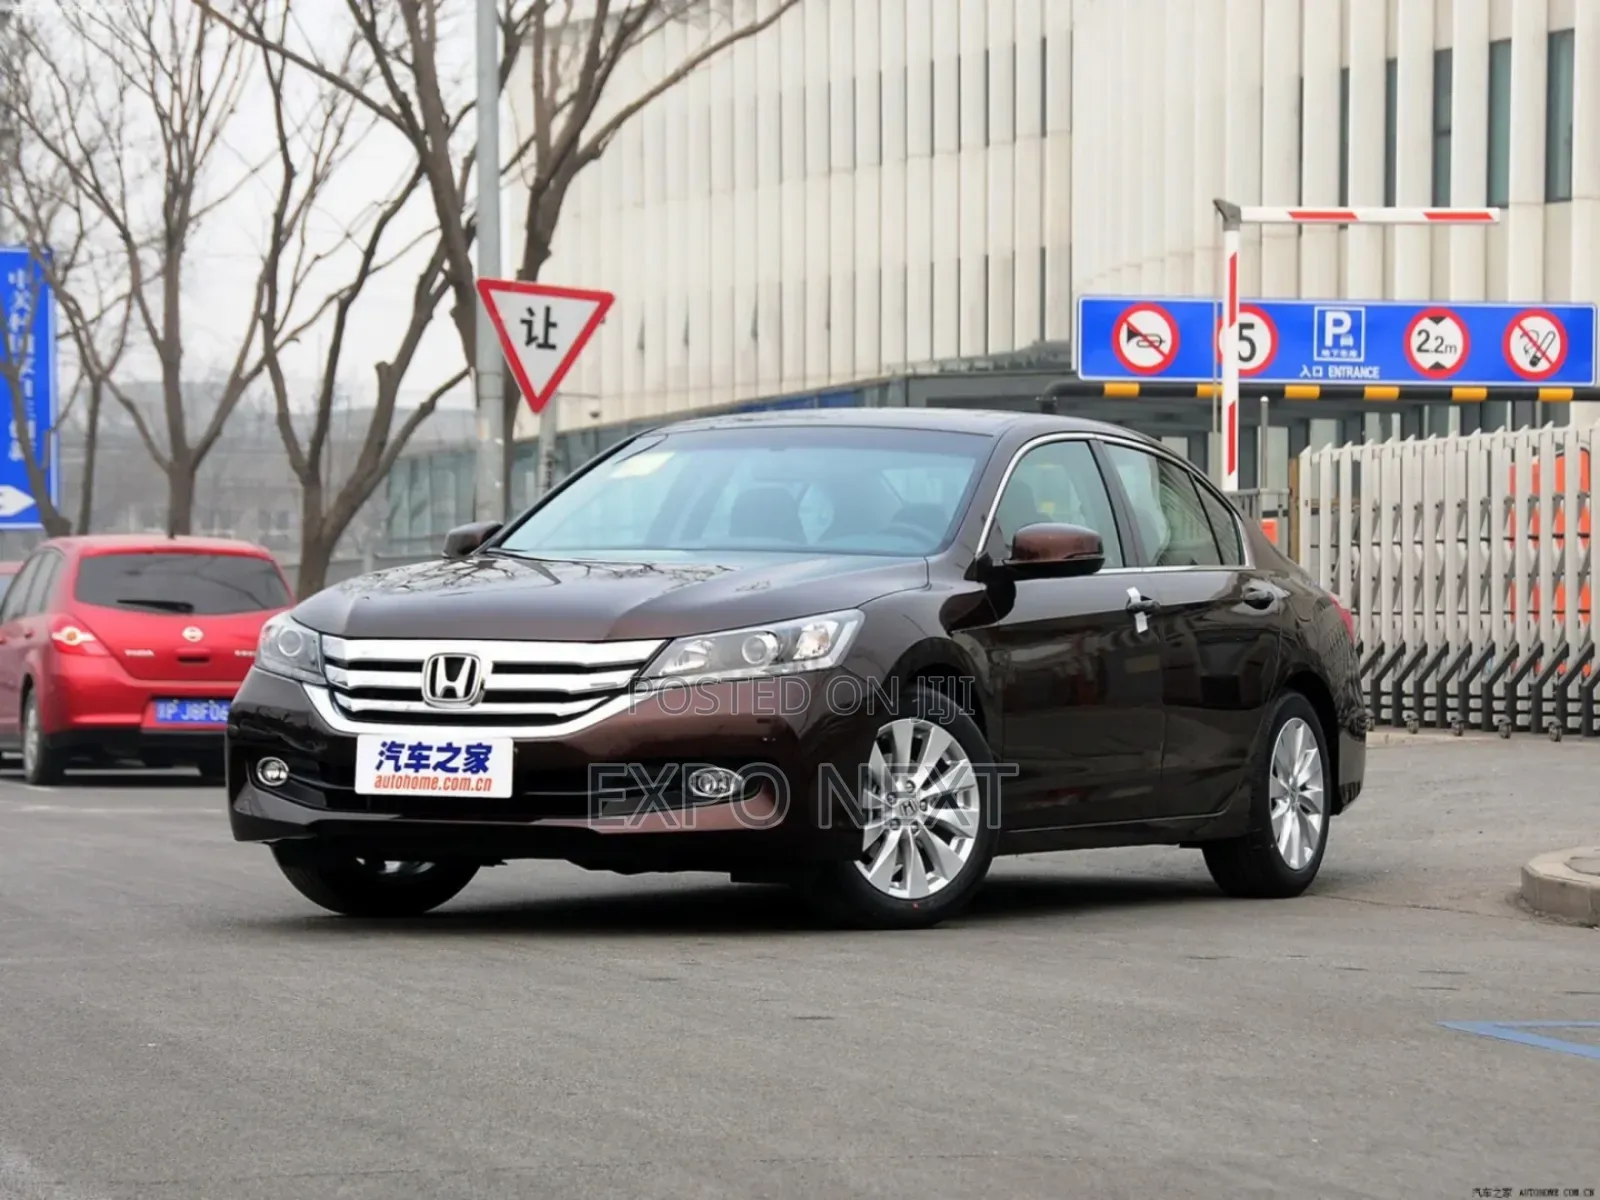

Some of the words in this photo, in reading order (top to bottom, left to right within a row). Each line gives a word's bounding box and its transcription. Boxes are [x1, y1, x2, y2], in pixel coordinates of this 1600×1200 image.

[520, 305, 558, 350] 让
[1238, 322, 1257, 363] 5
[1324, 310, 1352, 348] P
[1416, 328, 1457, 354] 2.2m
[1299, 364, 1323, 378] 入口
[1328, 365, 1380, 379] ENTRANCE
[375, 741, 493, 774] 汽车之家
[374, 774, 493, 792] autohome.com.cn
